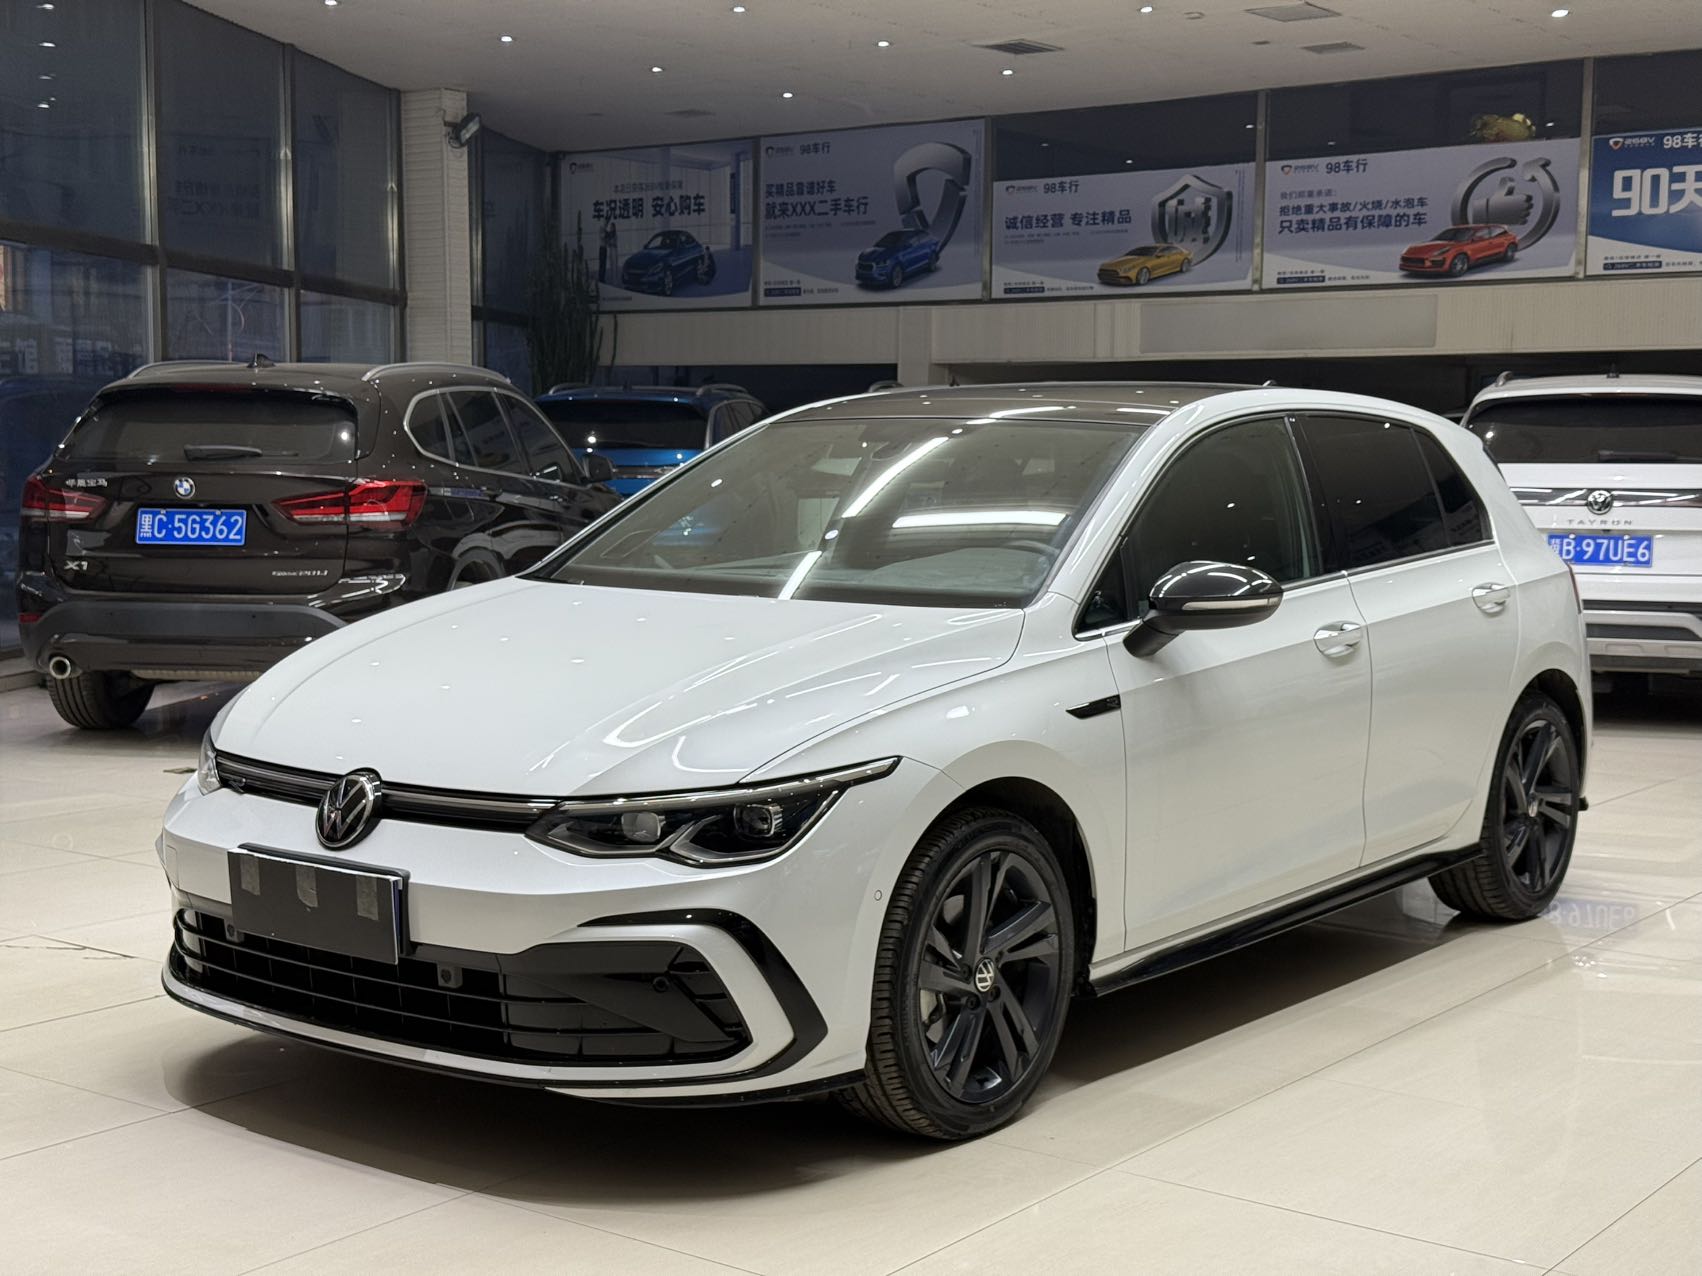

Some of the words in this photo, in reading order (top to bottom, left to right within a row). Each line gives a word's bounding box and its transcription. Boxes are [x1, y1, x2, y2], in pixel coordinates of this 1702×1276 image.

[1663, 133, 1702, 150] 98车
[1325, 158, 1368, 175] 98车行
[1043, 180, 1080, 195] 98车行
[1611, 164, 1702, 217] 90天
[592, 198, 644, 221] 车况透明
[651, 194, 706, 217] 安心购车
[764, 196, 869, 221] 就来XXX二手车行
[1279, 196, 1429, 217] 拒绝重大事故/火烧/水泡车
[1004, 212, 1065, 231] 诚信经营
[1069, 209, 1132, 228] 专注精品
[1278, 211, 1427, 235] 只卖精品有保障的车
[64, 561, 88, 570] X1
